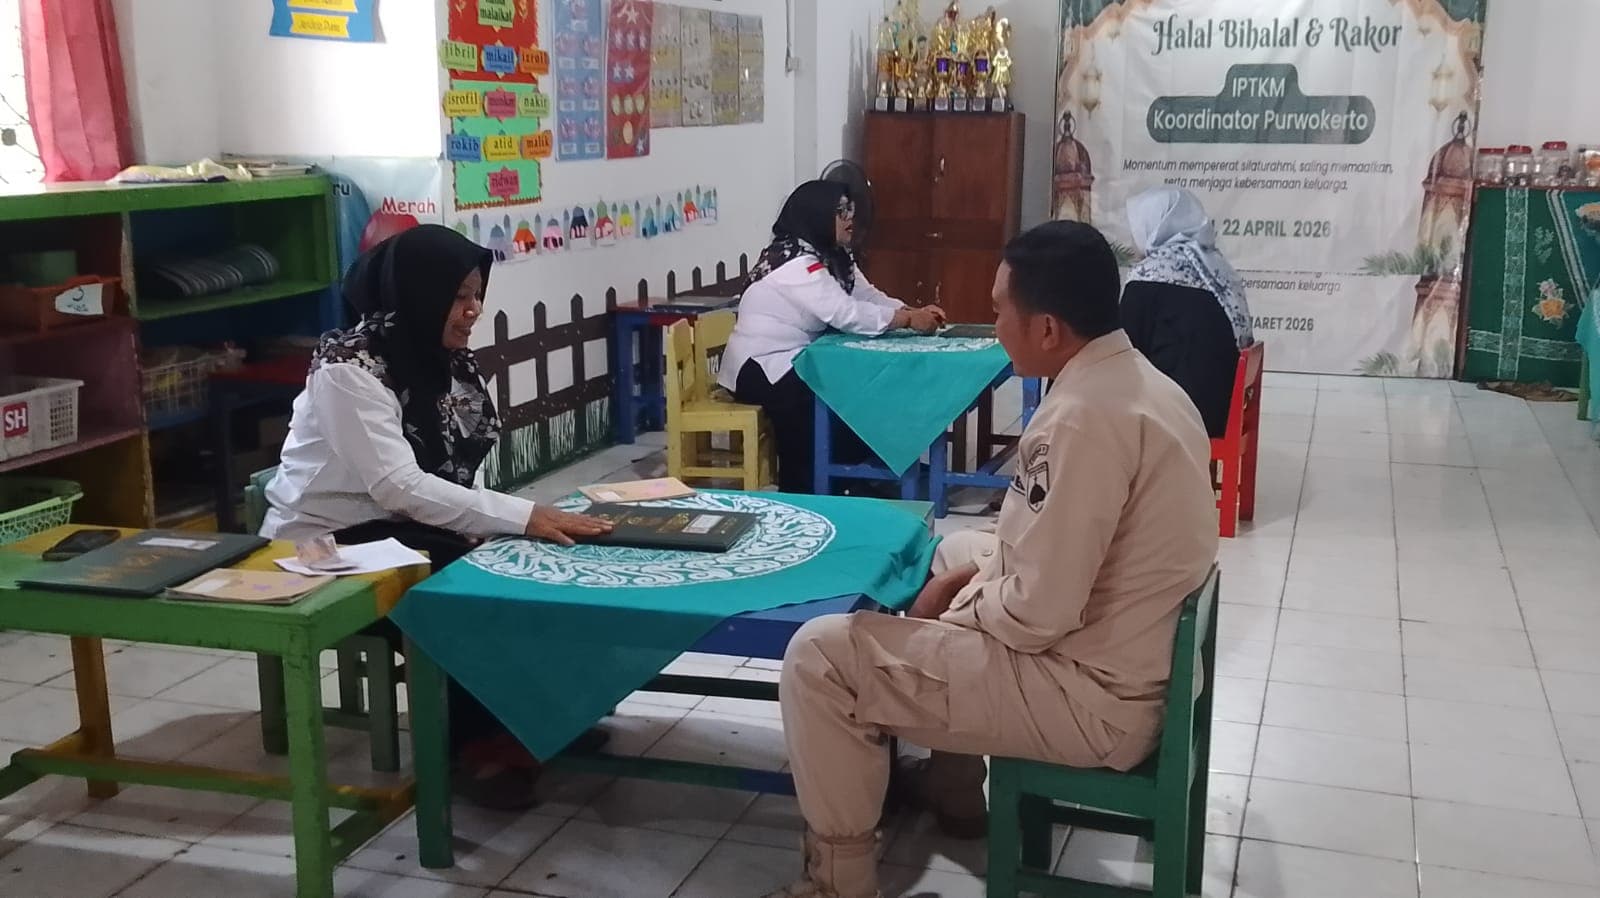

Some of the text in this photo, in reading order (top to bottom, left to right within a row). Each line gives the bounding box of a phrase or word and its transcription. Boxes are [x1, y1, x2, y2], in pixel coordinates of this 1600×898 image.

[1151, 13, 1402, 56] Halal Bihalal & Rakor
[1232, 77, 1286, 97] IPTKM
[1153, 109, 1369, 132] Koordinator Purwokerto
[1123, 160, 1177, 171] Momentum
[1179, 160, 1239, 174] mempererat
[1299, 160, 1329, 176] saling
[1189, 177, 1232, 192] menjaga
[382, 196, 436, 214] Merah
[1222, 219, 1240, 236] 22
[1244, 220, 1287, 237] APRIL
[1293, 220, 1331, 238] 2026
[1240, 278, 1296, 290] bersamaan
[1285, 318, 1314, 331] 2026
[5, 408, 27, 431] SH
